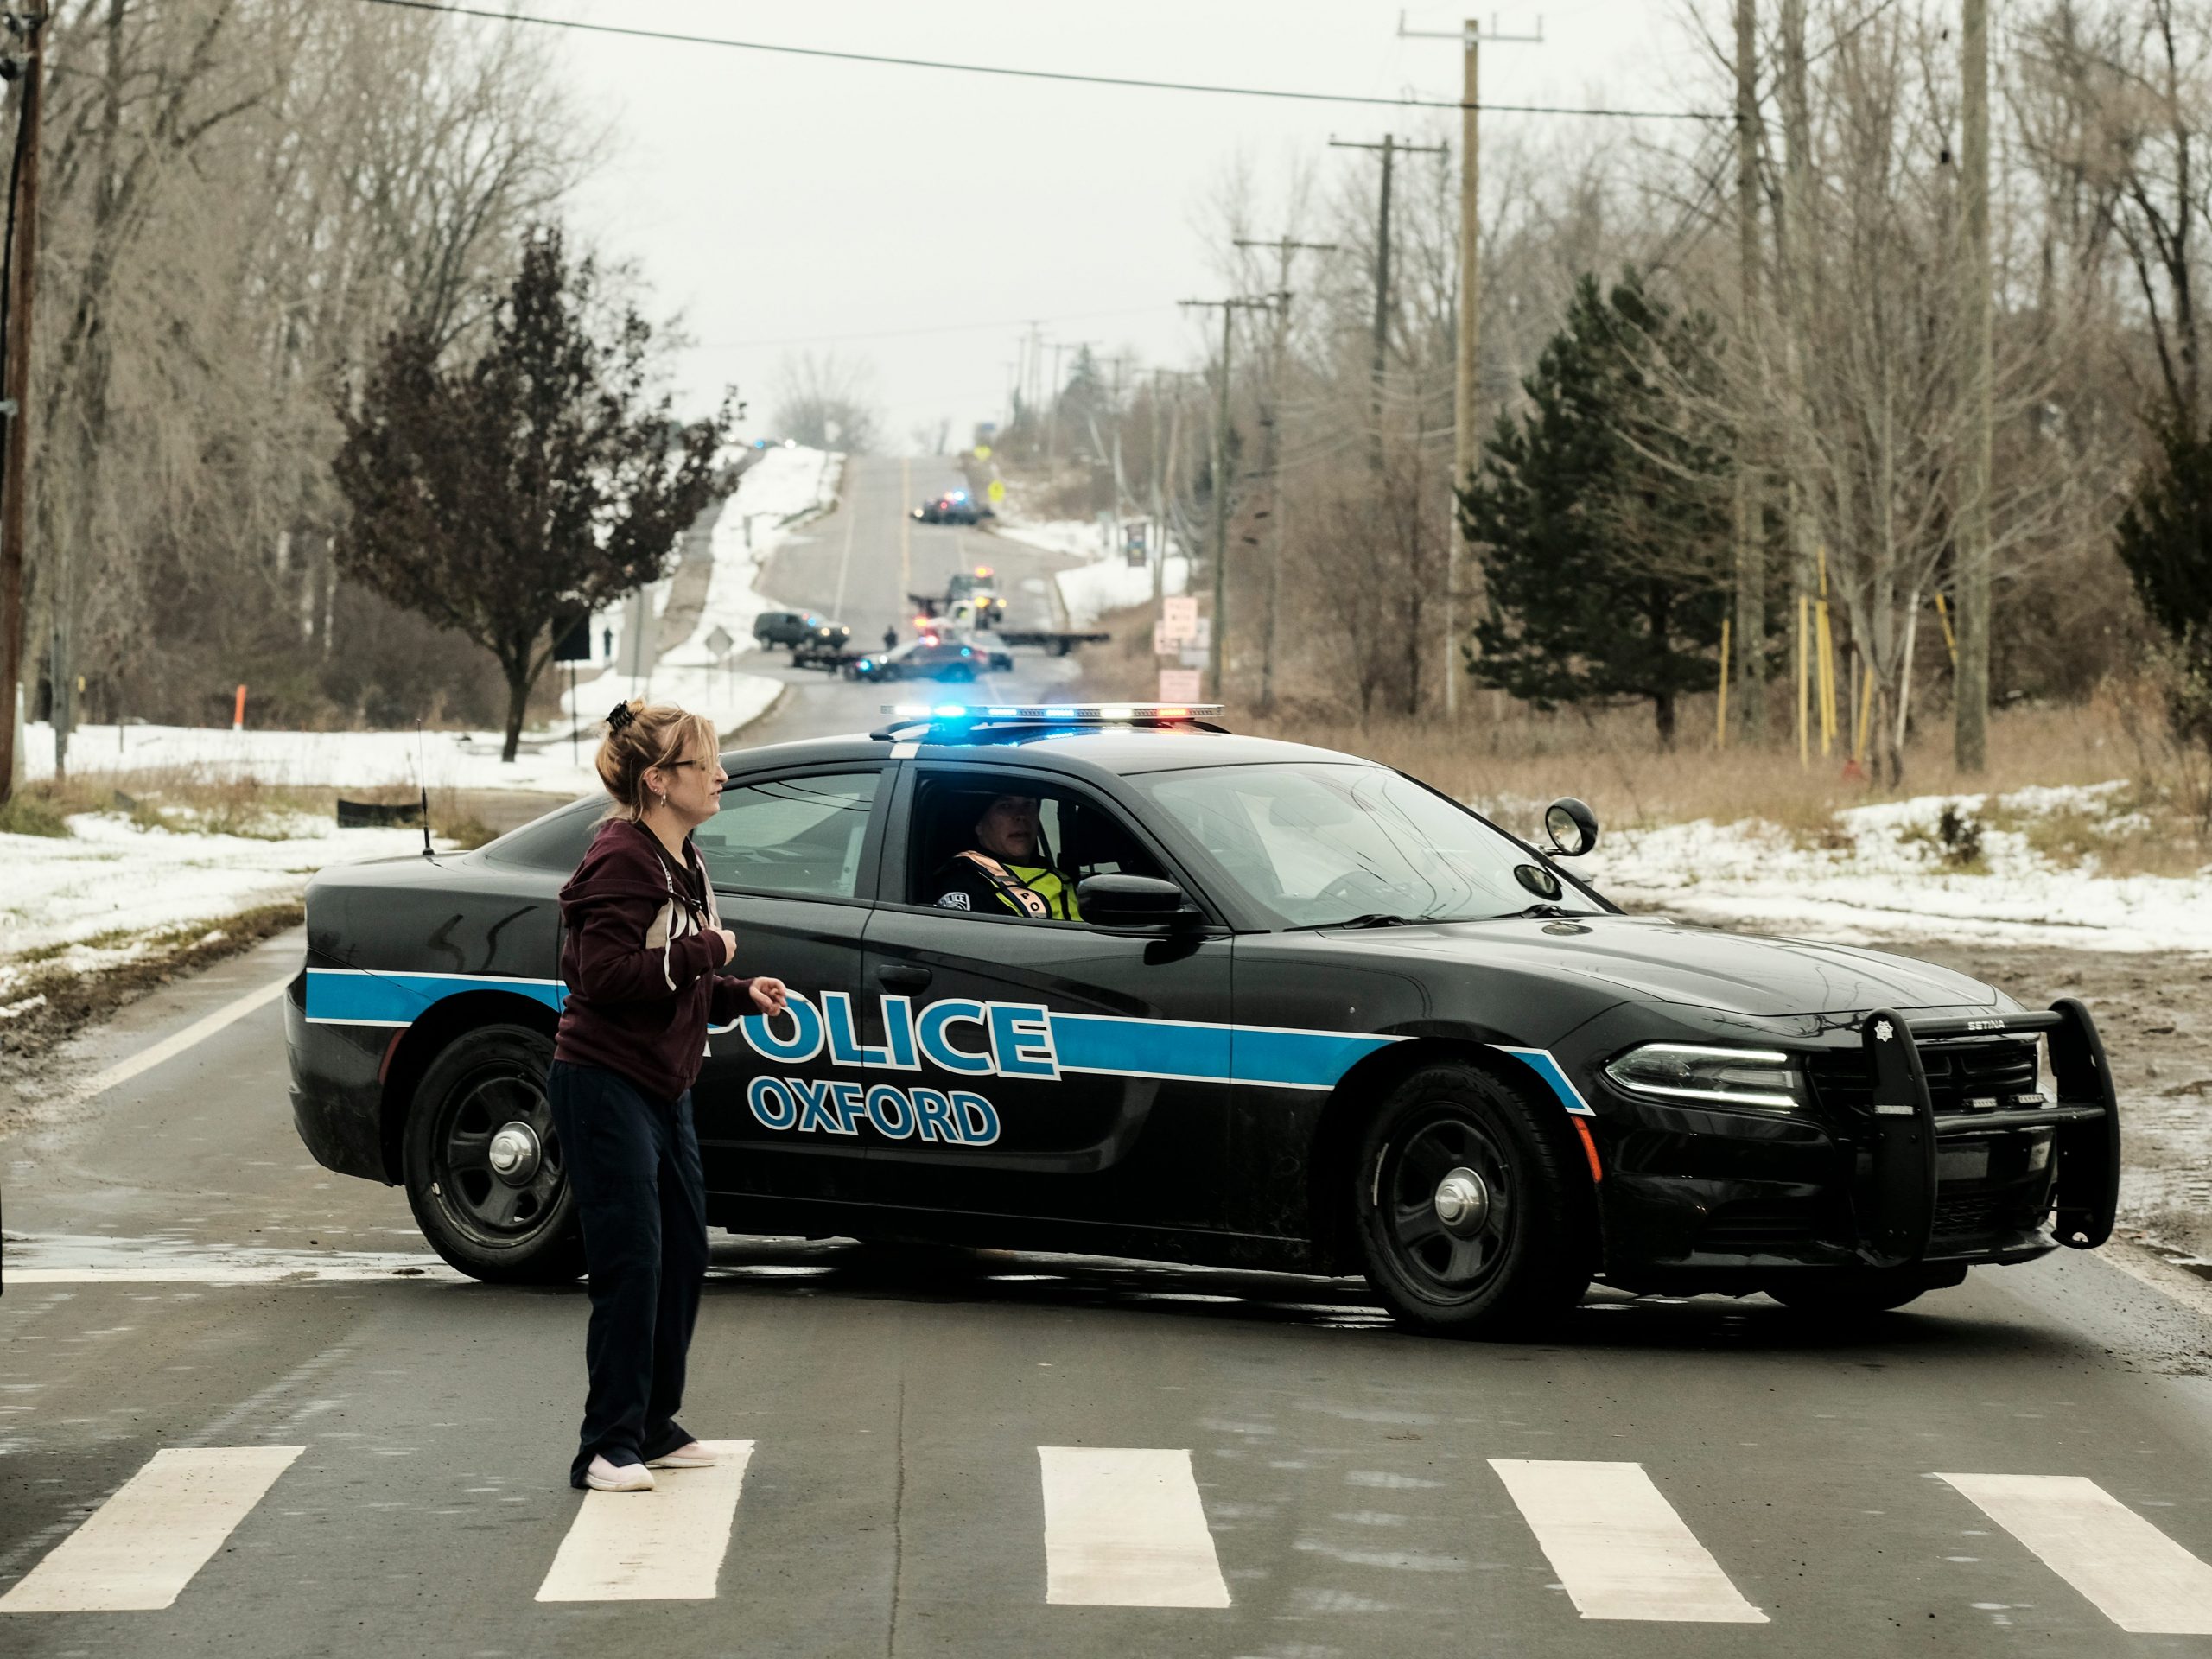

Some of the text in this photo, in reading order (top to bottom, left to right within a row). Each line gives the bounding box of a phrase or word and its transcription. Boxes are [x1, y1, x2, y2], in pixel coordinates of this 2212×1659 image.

[1020, 893, 1039, 917] PO
[702, 990, 1062, 1081] OLICE
[1967, 1020, 2005, 1030] SETINA
[747, 1075, 1001, 1147] OXFORD
